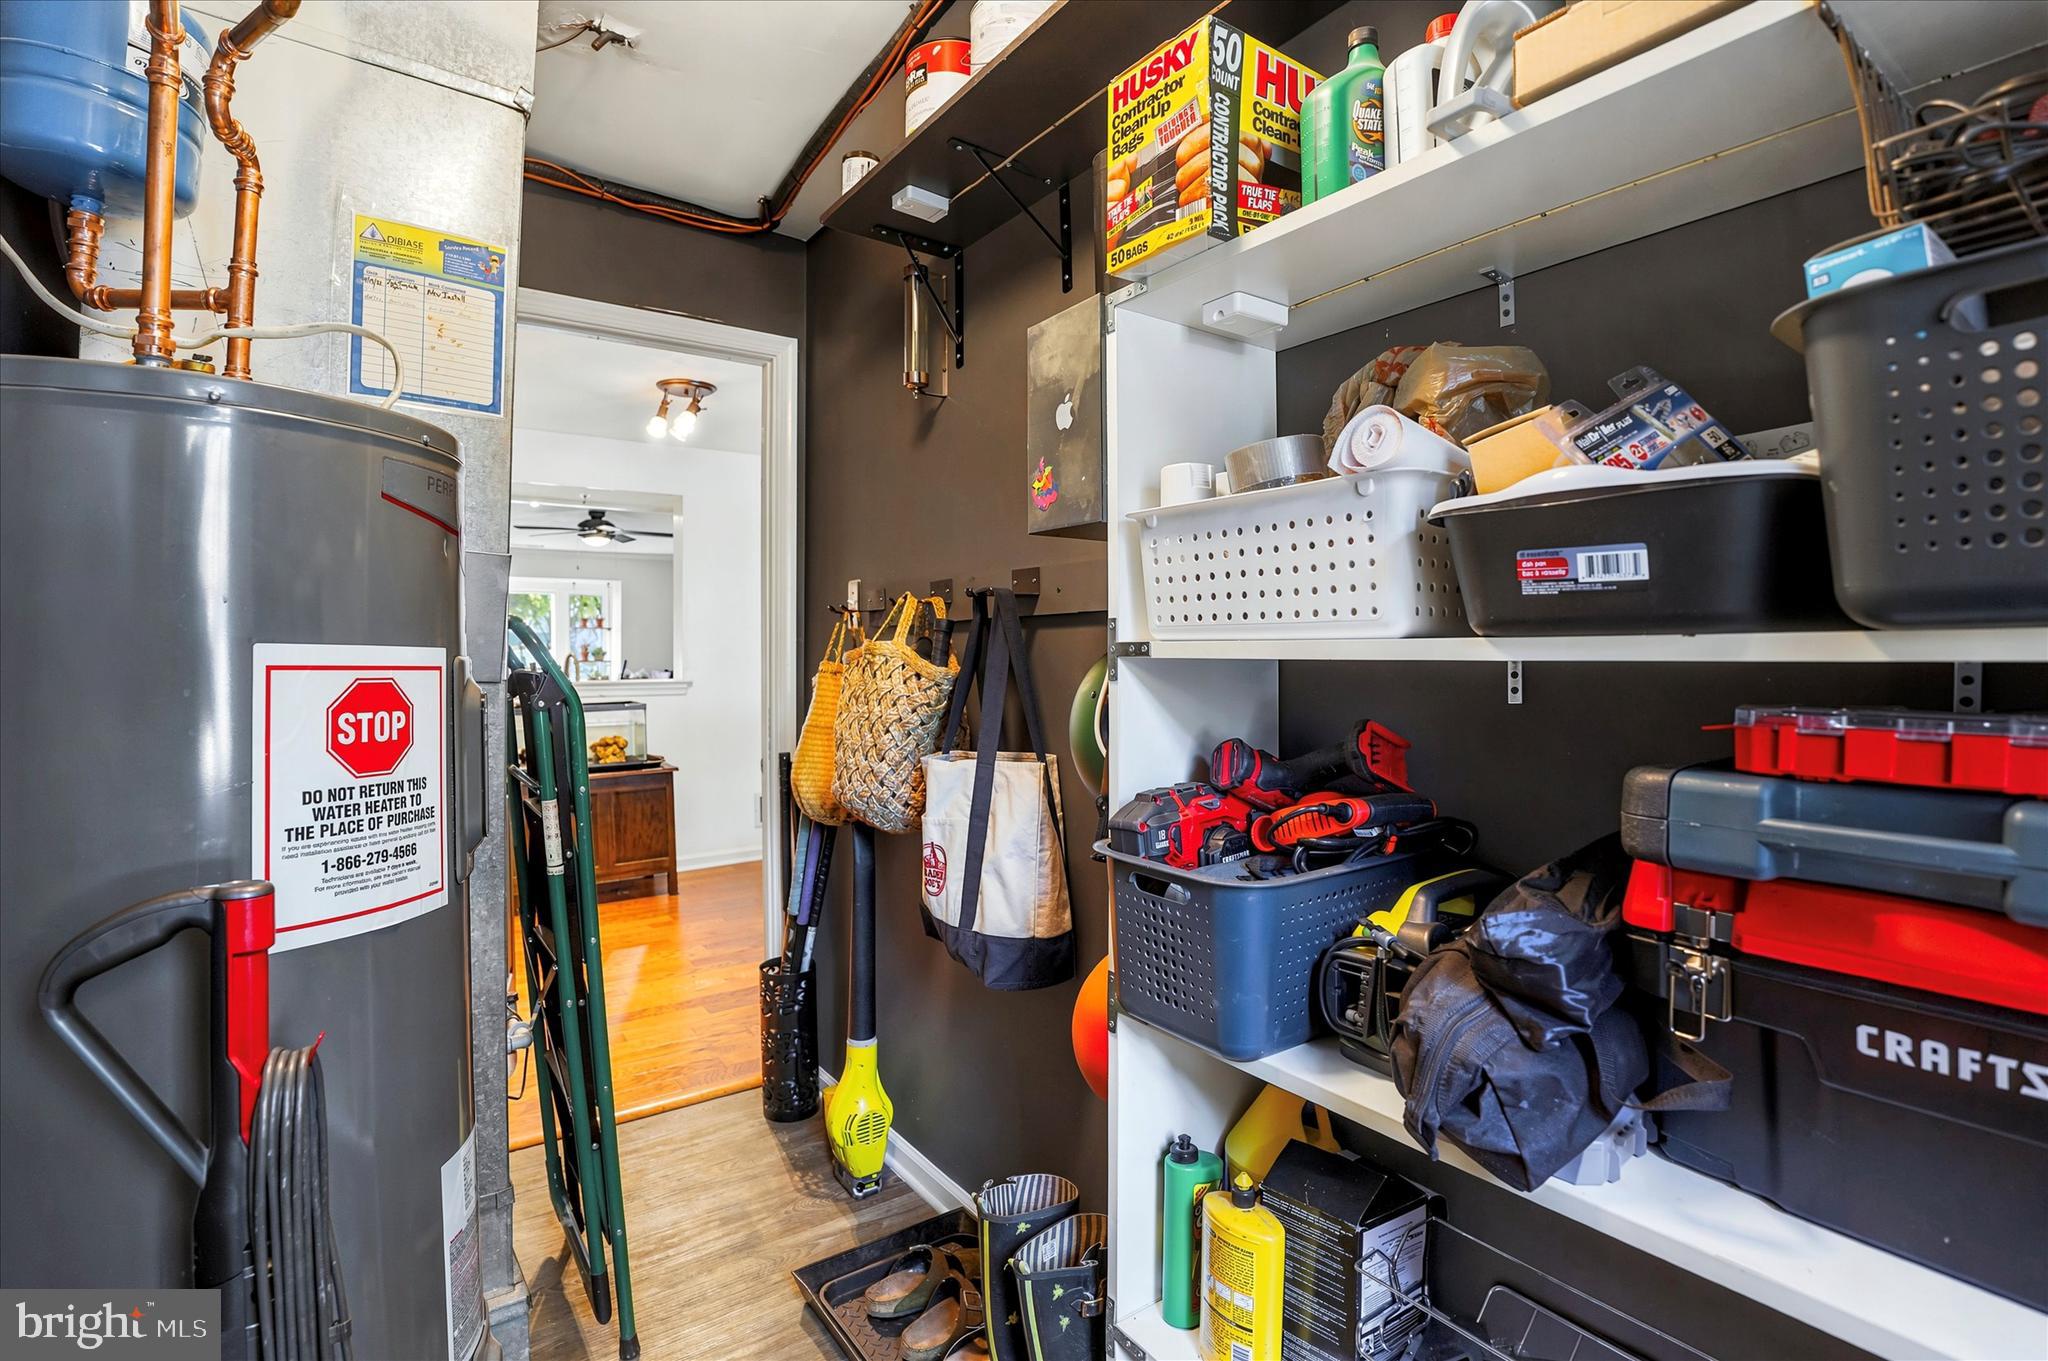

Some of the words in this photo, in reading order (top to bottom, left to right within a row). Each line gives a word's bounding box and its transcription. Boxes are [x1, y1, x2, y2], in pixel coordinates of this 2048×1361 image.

[1212, 24, 1242, 73] 50
[1113, 30, 1199, 114] HUSKY
[1211, 64, 1240, 91] COUNT
[1111, 75, 1186, 130] Contractor
[1352, 99, 1382, 120] QUAKE
[1111, 100, 1171, 145] Clean-Up
[1111, 131, 1145, 160] Bags
[1212, 92, 1231, 191] CONTRACTOR
[1351, 142, 1375, 158] Peak
[1241, 184, 1264, 198] TRUE
[1264, 188, 1277, 200] TIE
[1247, 197, 1273, 211] FLAPS
[1112, 208, 1130, 226] FLAPS
[1212, 192, 1229, 232] PACK
[386, 235, 424, 250] DIBIASE
[1110, 248, 1126, 267] 50
[1125, 241, 1149, 260] BAGS
[337, 710, 406, 745] STOP
[302, 789, 323, 805] DO
[328, 786, 355, 802] NOT
[359, 780, 404, 799] RETURN
[407, 776, 427, 792] THIS
[312, 802, 361, 822] WATER
[365, 796, 407, 815] HEATER
[410, 793, 422, 807] TO
[284, 825, 314, 842] THE
[320, 819, 364, 839] PLACE
[368, 816, 383, 831] OF
[387, 806, 435, 828] PURCHASE
[1158, 829, 1166, 840] 18
[288, 845, 300, 853] you
[321, 842, 417, 874] 1-866-279-4566
